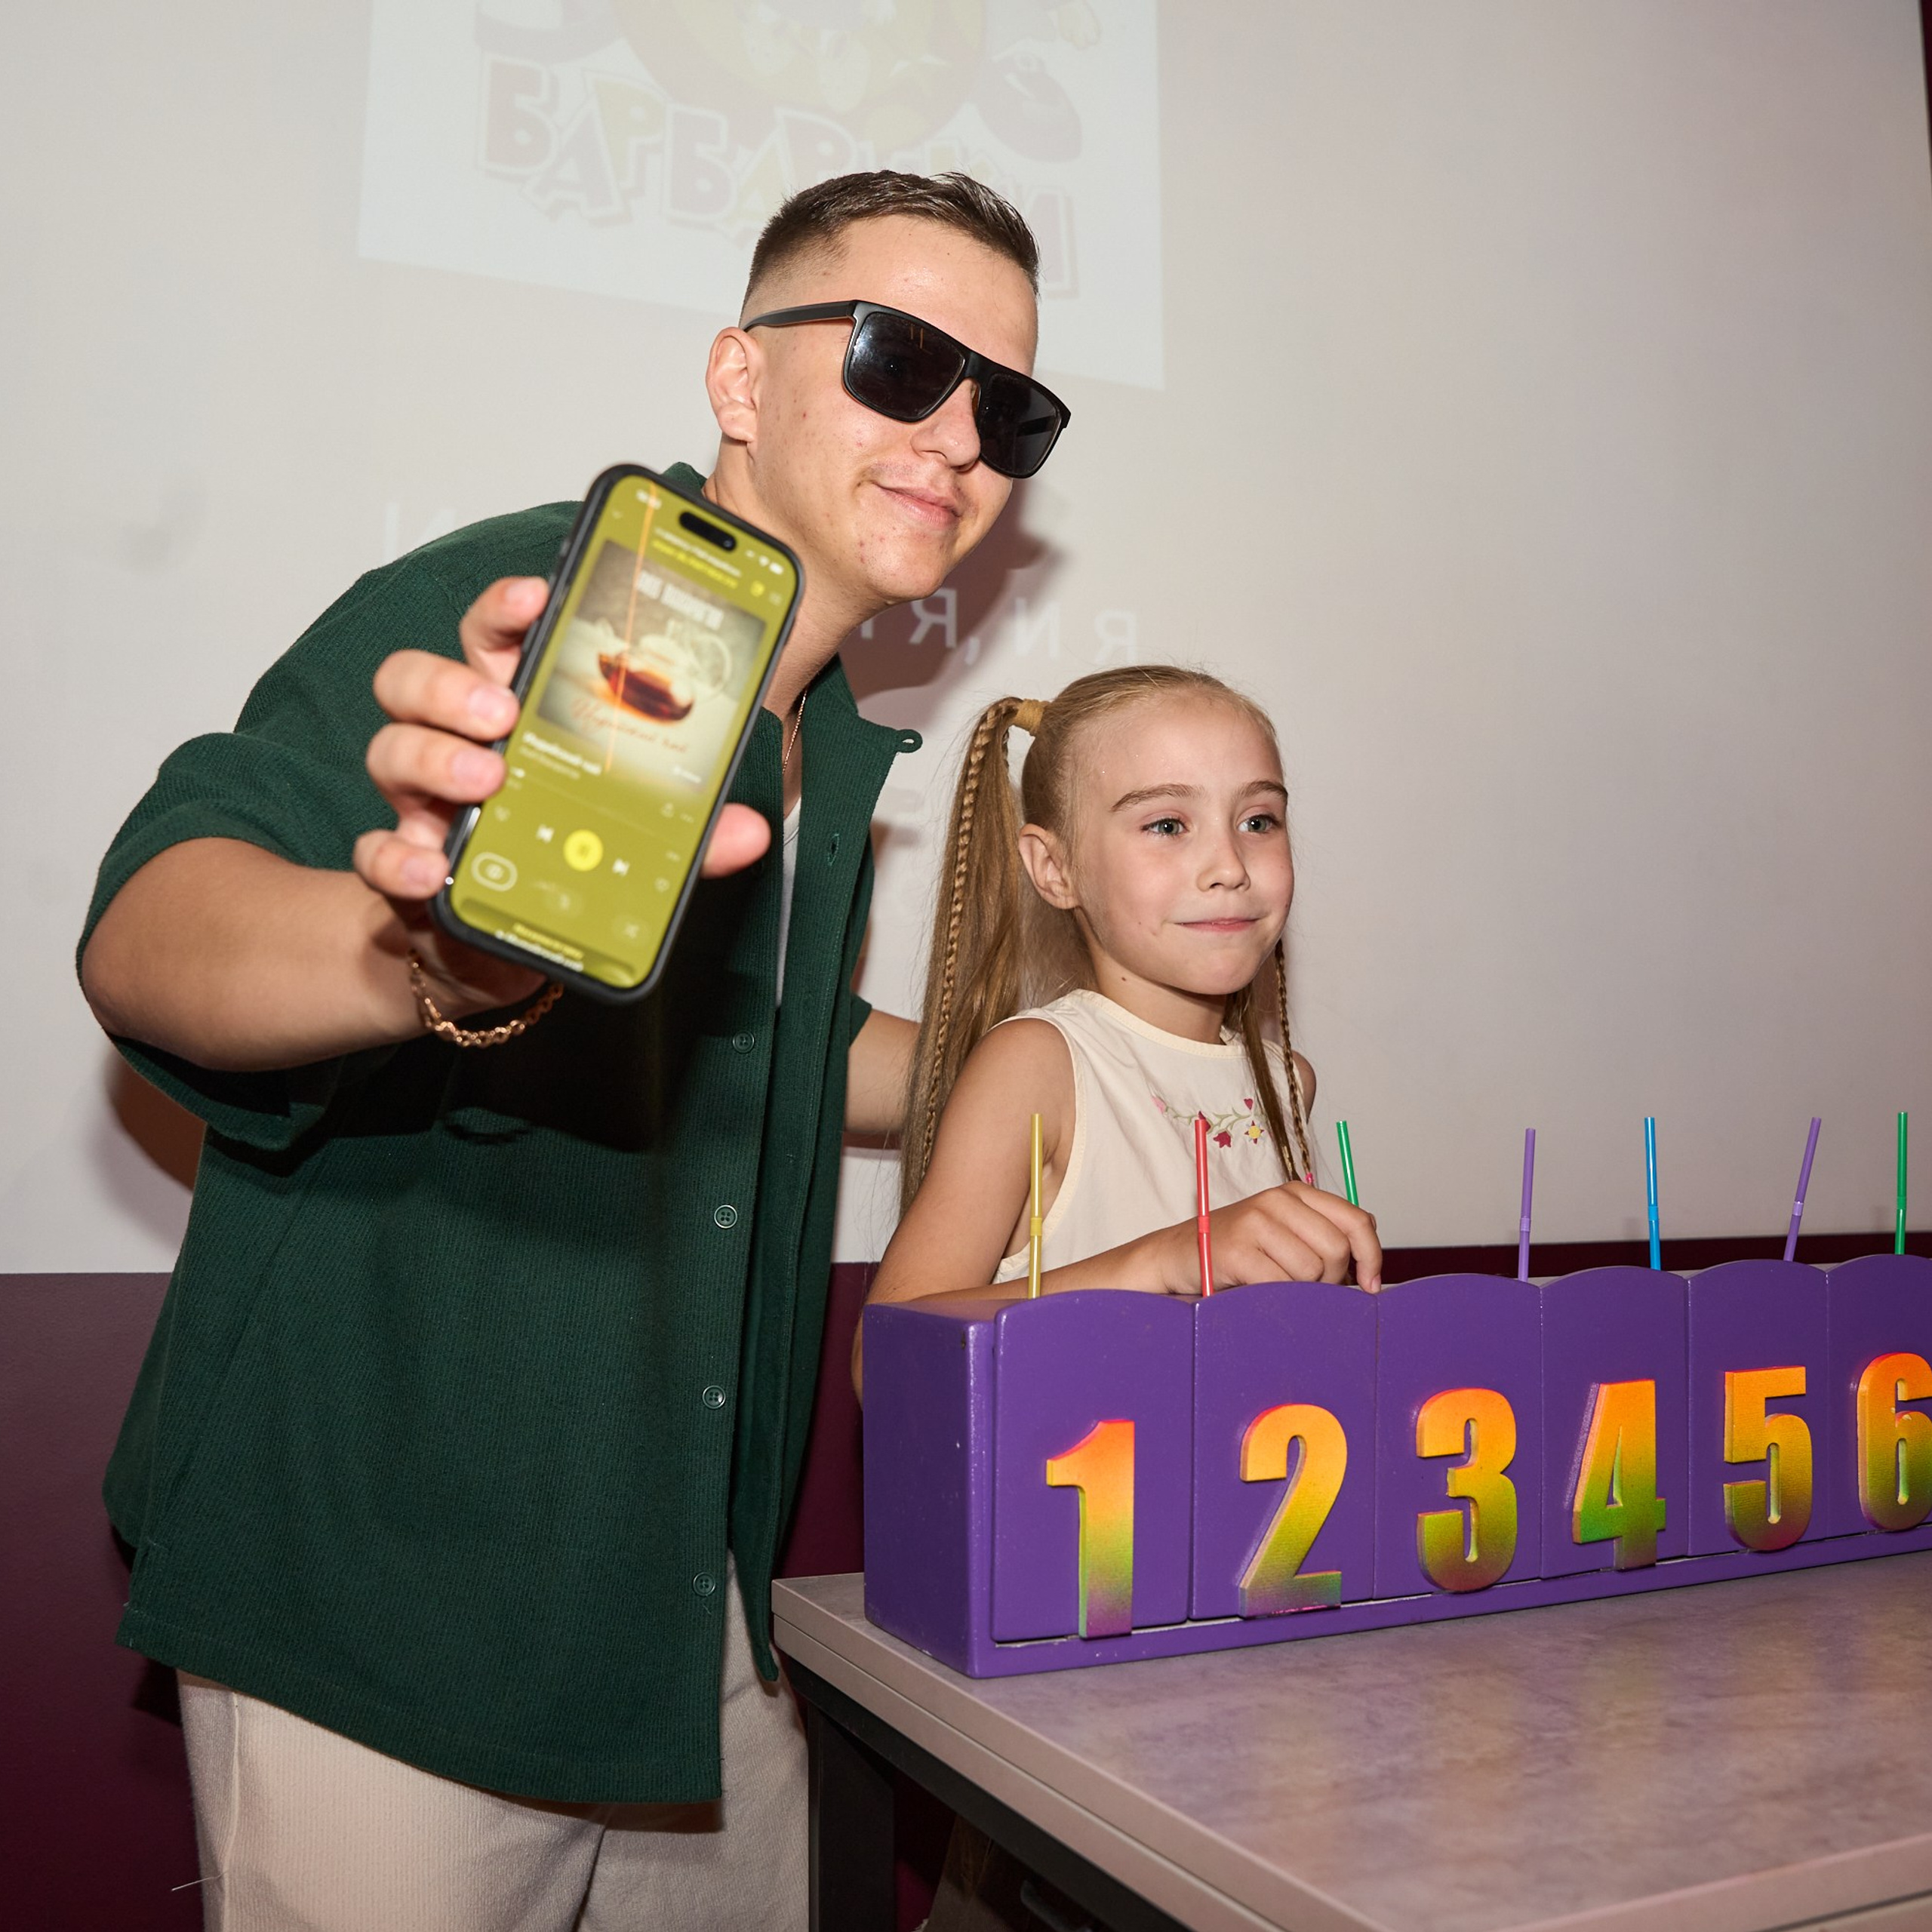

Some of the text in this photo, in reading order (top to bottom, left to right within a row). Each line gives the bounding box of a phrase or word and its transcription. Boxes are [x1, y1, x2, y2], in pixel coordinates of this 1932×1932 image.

[1046, 1352, 1932, 1638] 1 2 3 4 5 6
